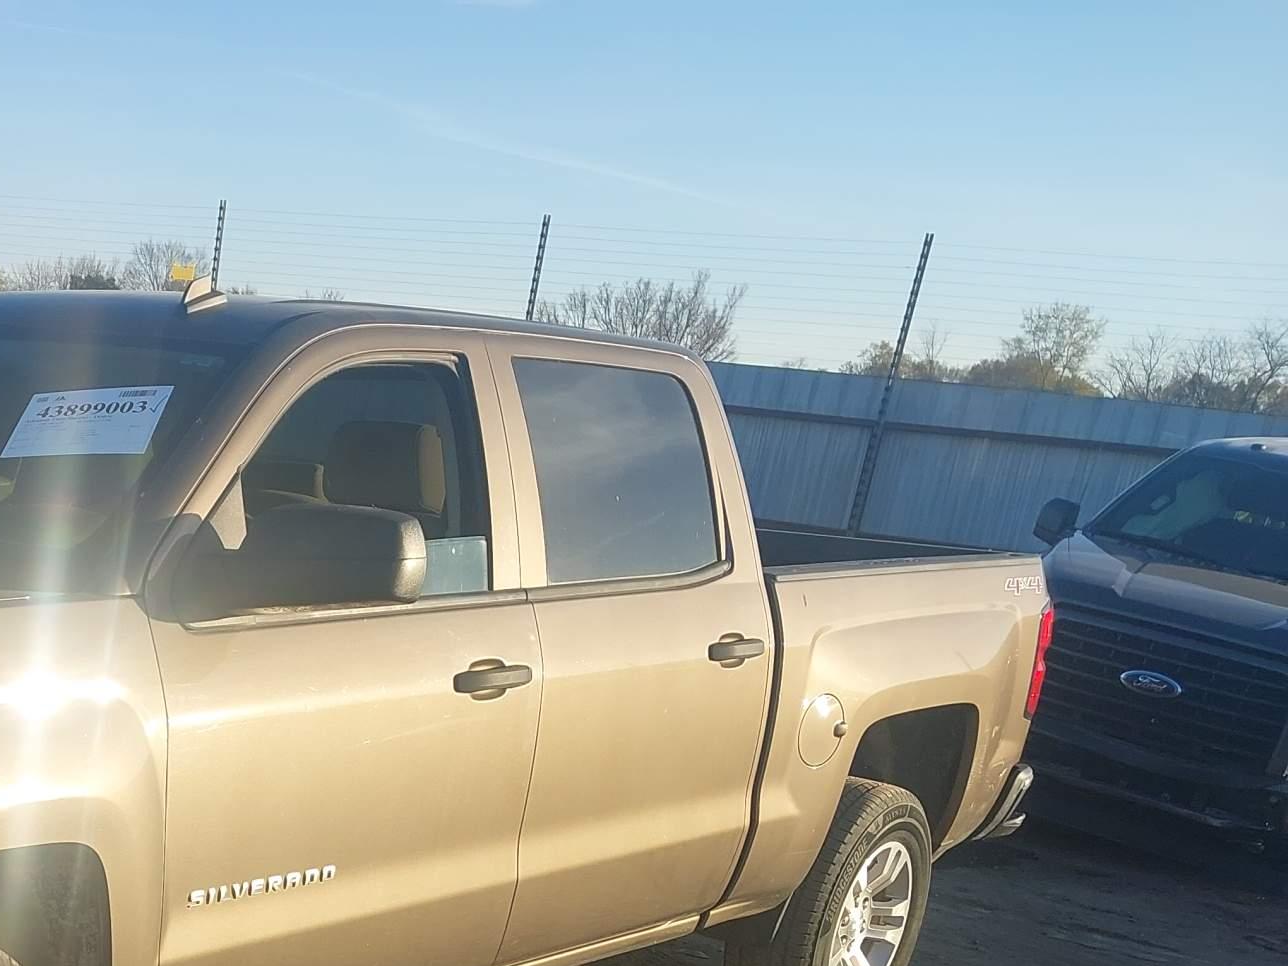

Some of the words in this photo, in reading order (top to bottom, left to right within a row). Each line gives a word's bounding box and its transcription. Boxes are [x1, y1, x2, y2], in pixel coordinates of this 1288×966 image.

[36, 400, 148, 418] 43899003
[186, 864, 337, 908] SILVERADO
[827, 836, 869, 921] BRIDGESTONE
